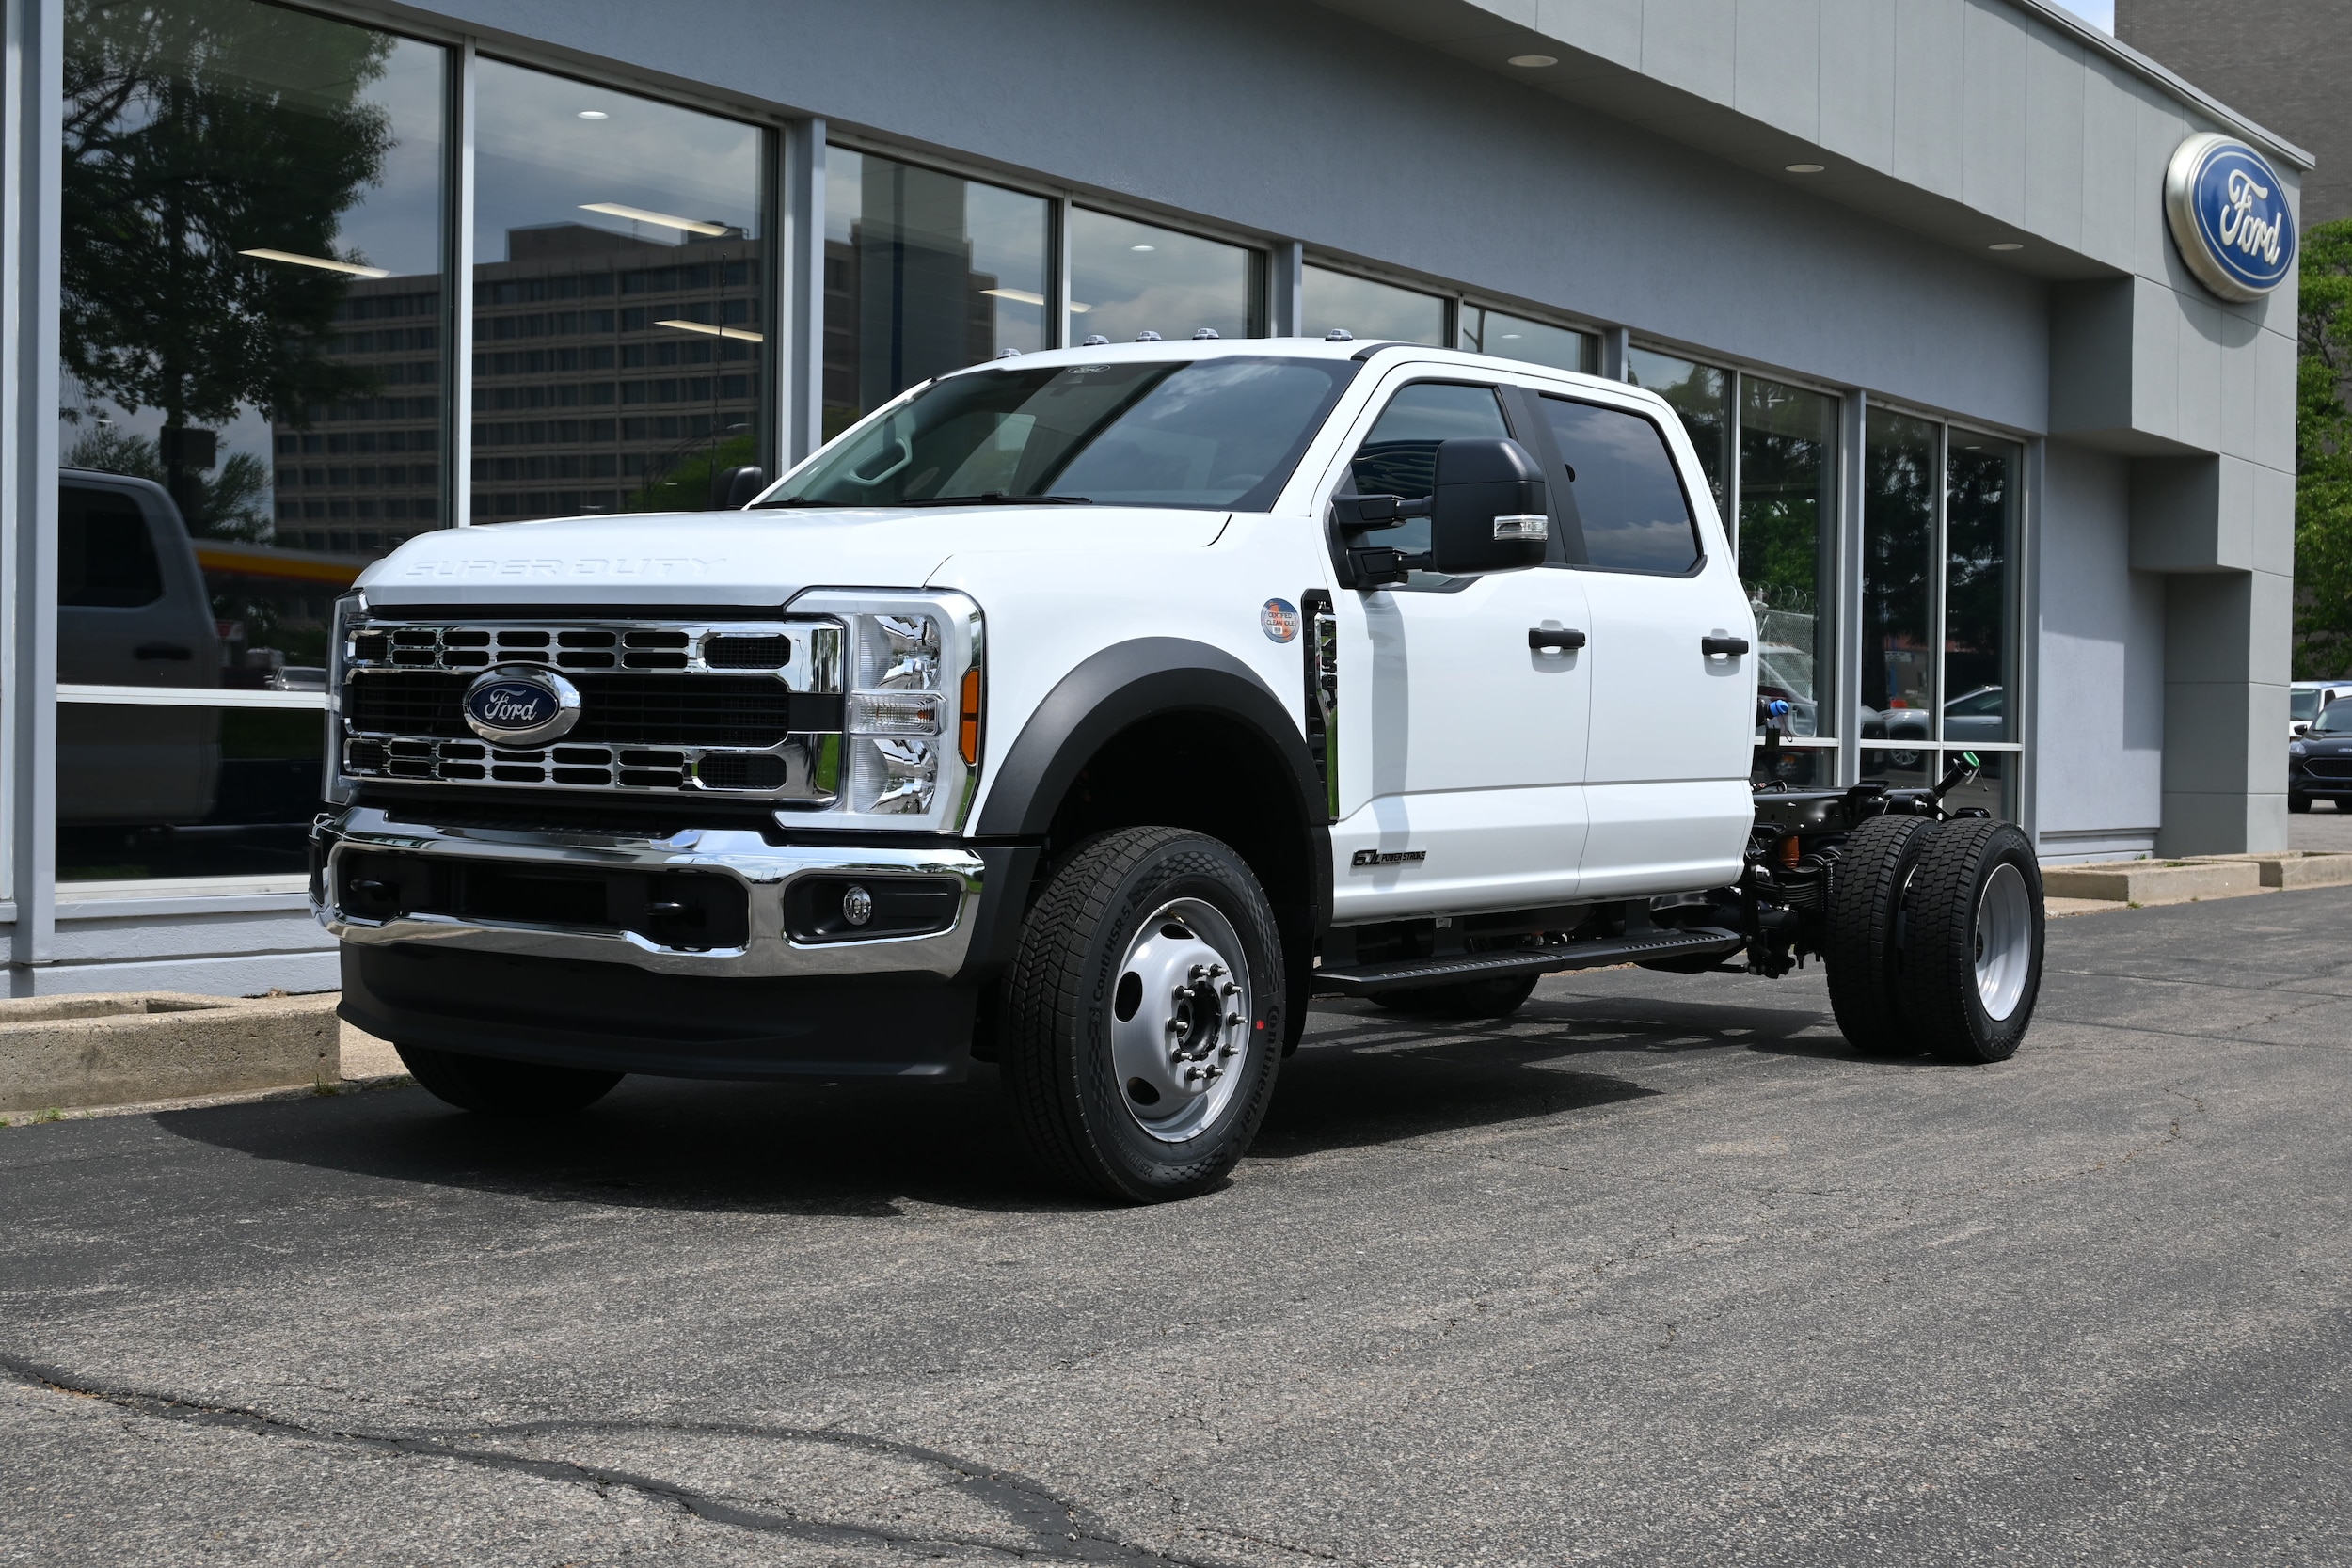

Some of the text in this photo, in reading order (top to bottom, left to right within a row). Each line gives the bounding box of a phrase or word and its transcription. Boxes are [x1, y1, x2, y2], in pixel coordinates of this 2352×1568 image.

[2220, 168, 2282, 266] Ford
[405, 557, 728, 578] SUPER DUTY
[1317, 600, 1330, 610] XL
[484, 688, 539, 721] Ford
[1381, 852, 1402, 862] POWER
[1402, 850, 1426, 861] STROKE
[1093, 904, 1132, 1003] Conti HSR 5
[1242, 1005, 1279, 1133] Continental
